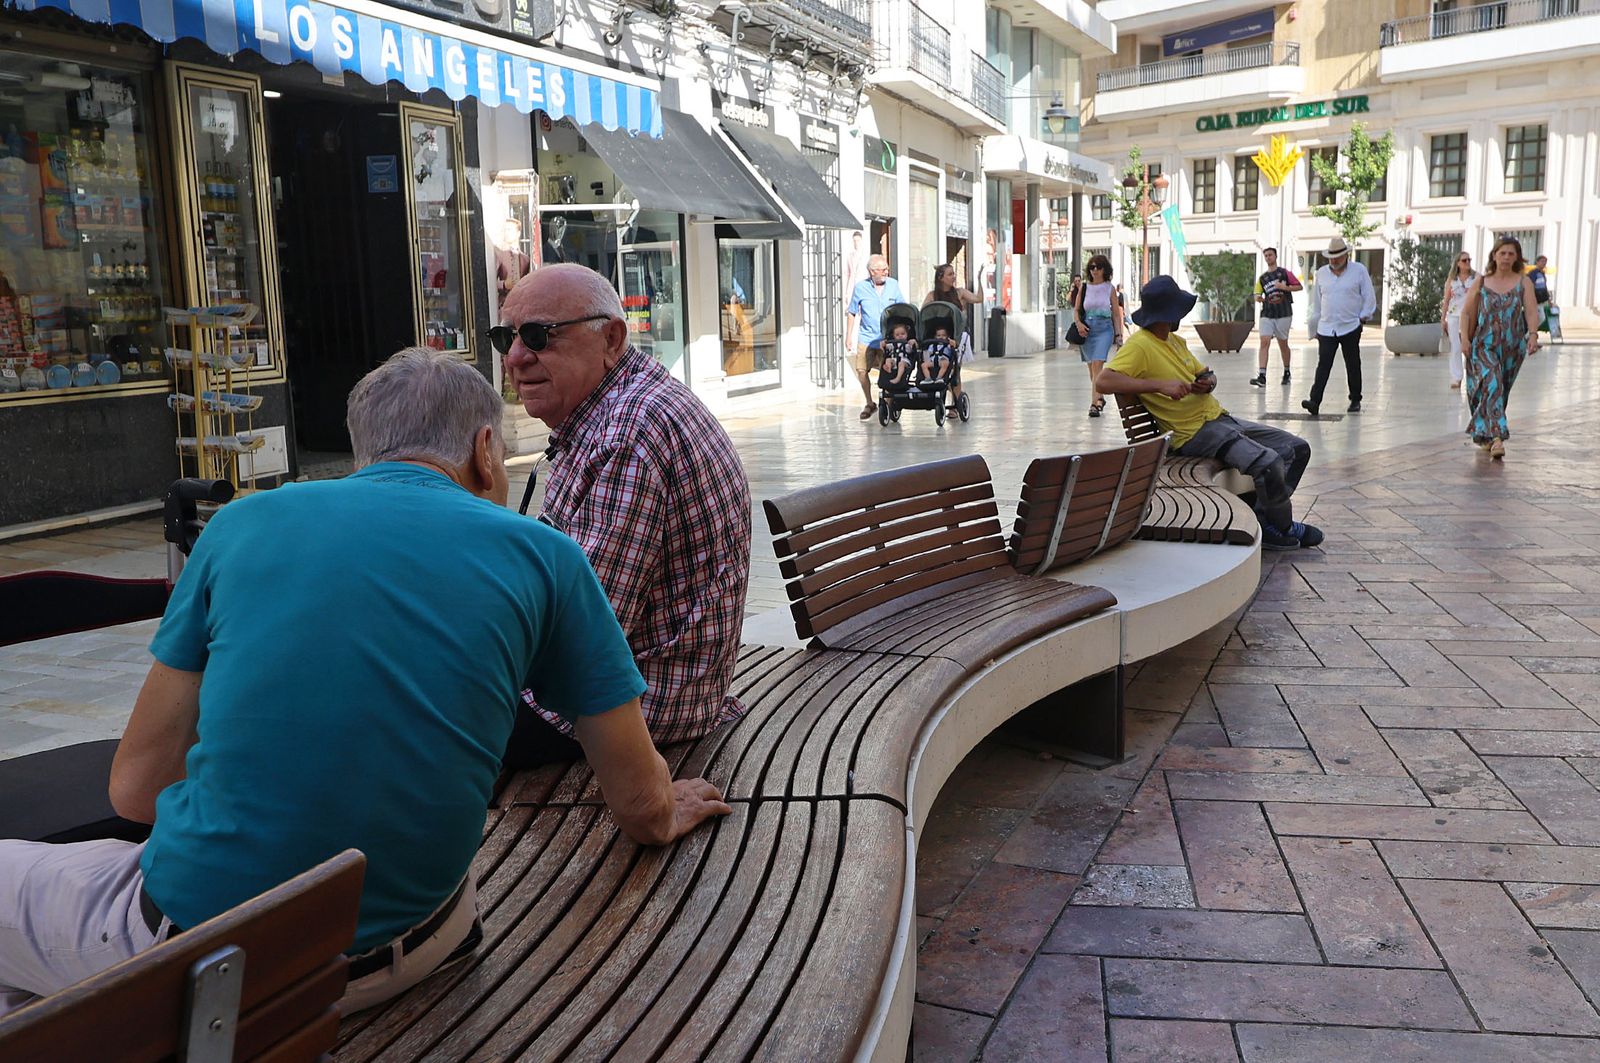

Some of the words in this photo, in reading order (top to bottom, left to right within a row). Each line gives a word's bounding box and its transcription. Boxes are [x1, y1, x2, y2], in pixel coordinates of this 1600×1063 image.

[254, 0, 354, 60] LOS
[380, 29, 566, 107] ANGELES
[1195, 113, 1233, 132] CAJA
[1236, 105, 1290, 127] RURAL
[1293, 101, 1329, 121] DEL
[1332, 94, 1370, 116] SUR
